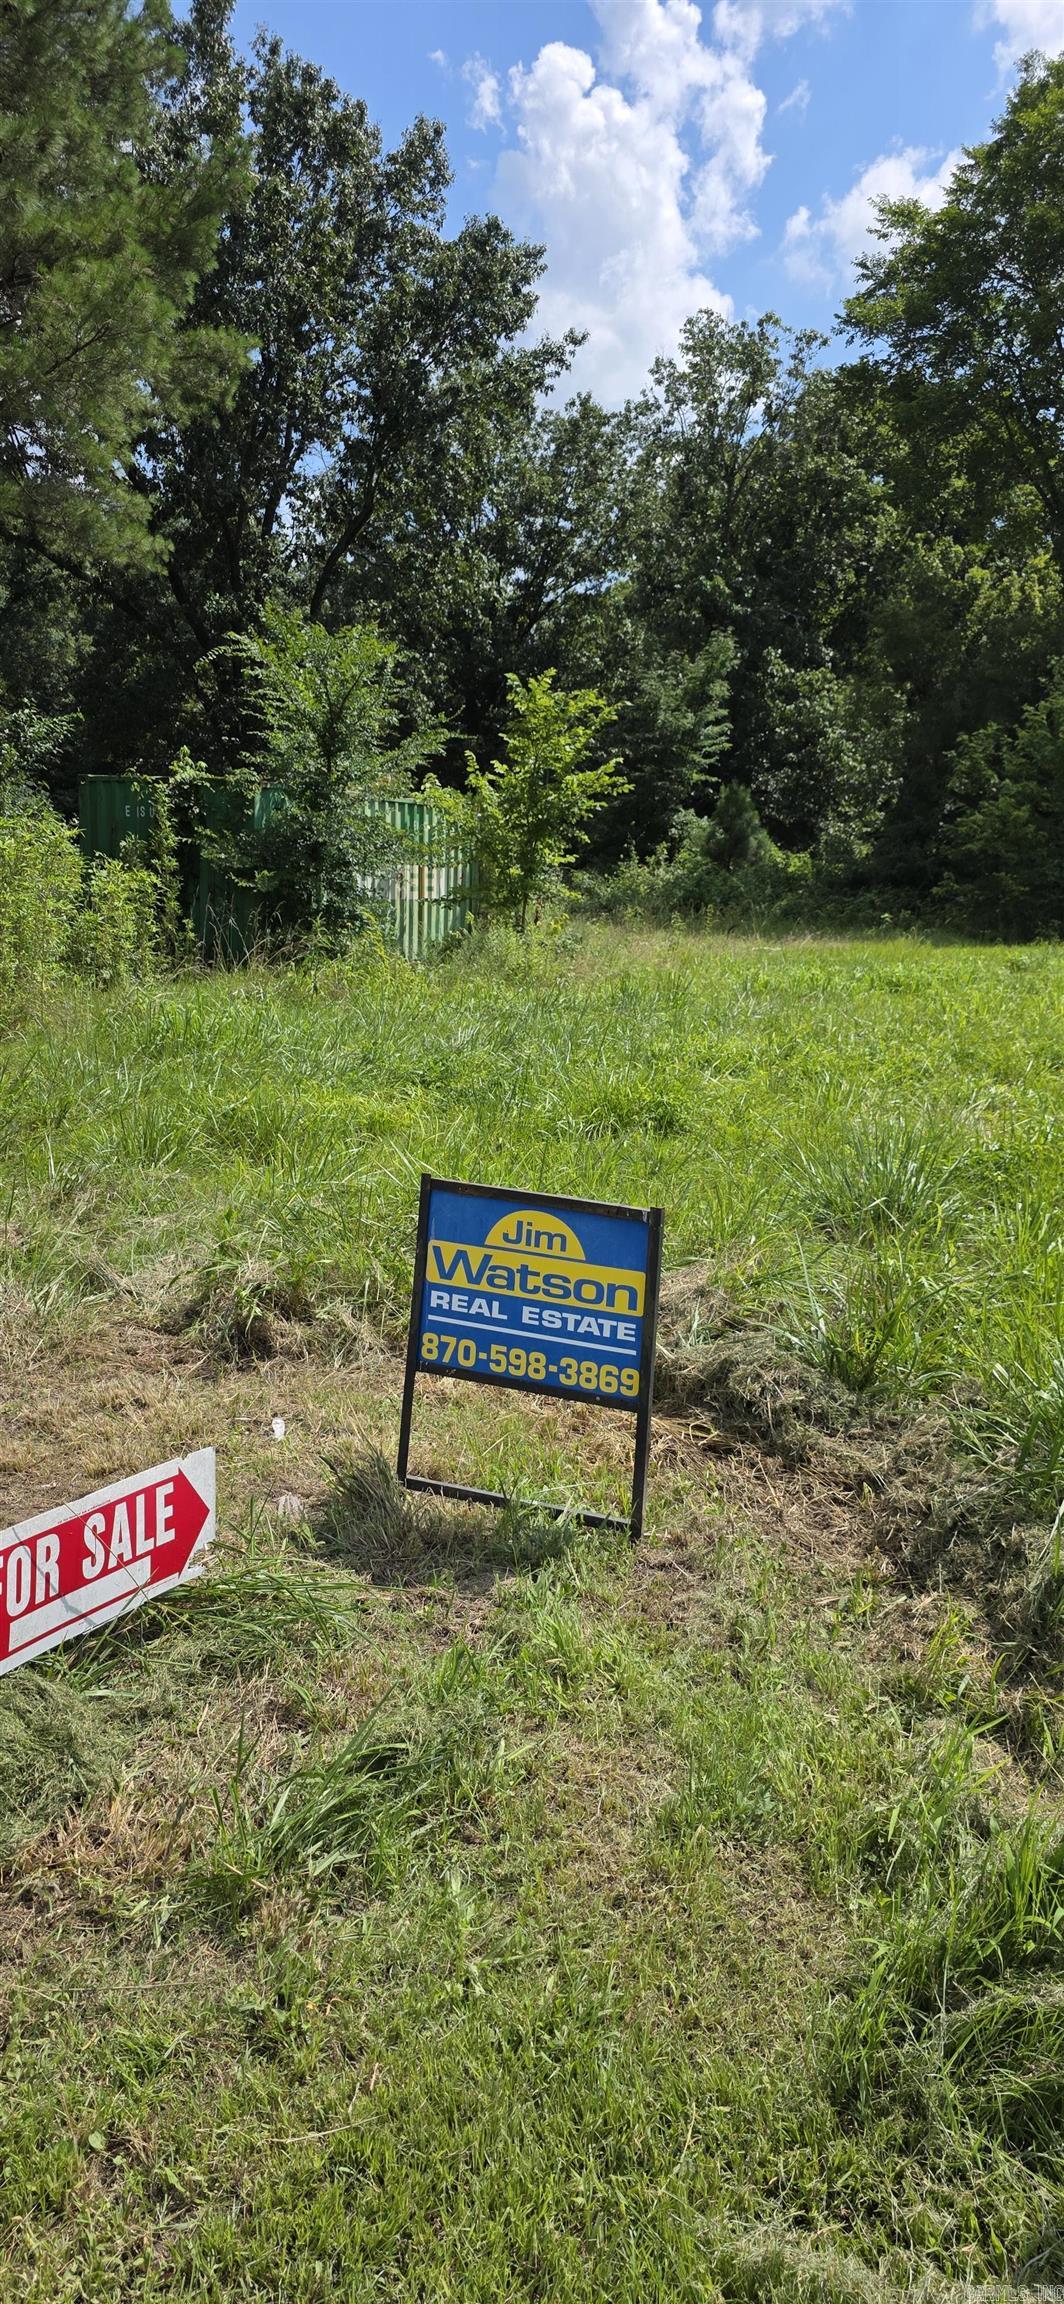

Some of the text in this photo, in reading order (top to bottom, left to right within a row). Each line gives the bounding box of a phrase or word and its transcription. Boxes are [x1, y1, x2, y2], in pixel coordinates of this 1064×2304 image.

[502, 1220, 567, 1252] Jim
[432, 1245, 638, 1311] Watson
[430, 1290, 636, 1342] REAL ESTATE
[421, 1332, 640, 1397] 870-598-3869
[0, 1481, 176, 1617] OR SALE
